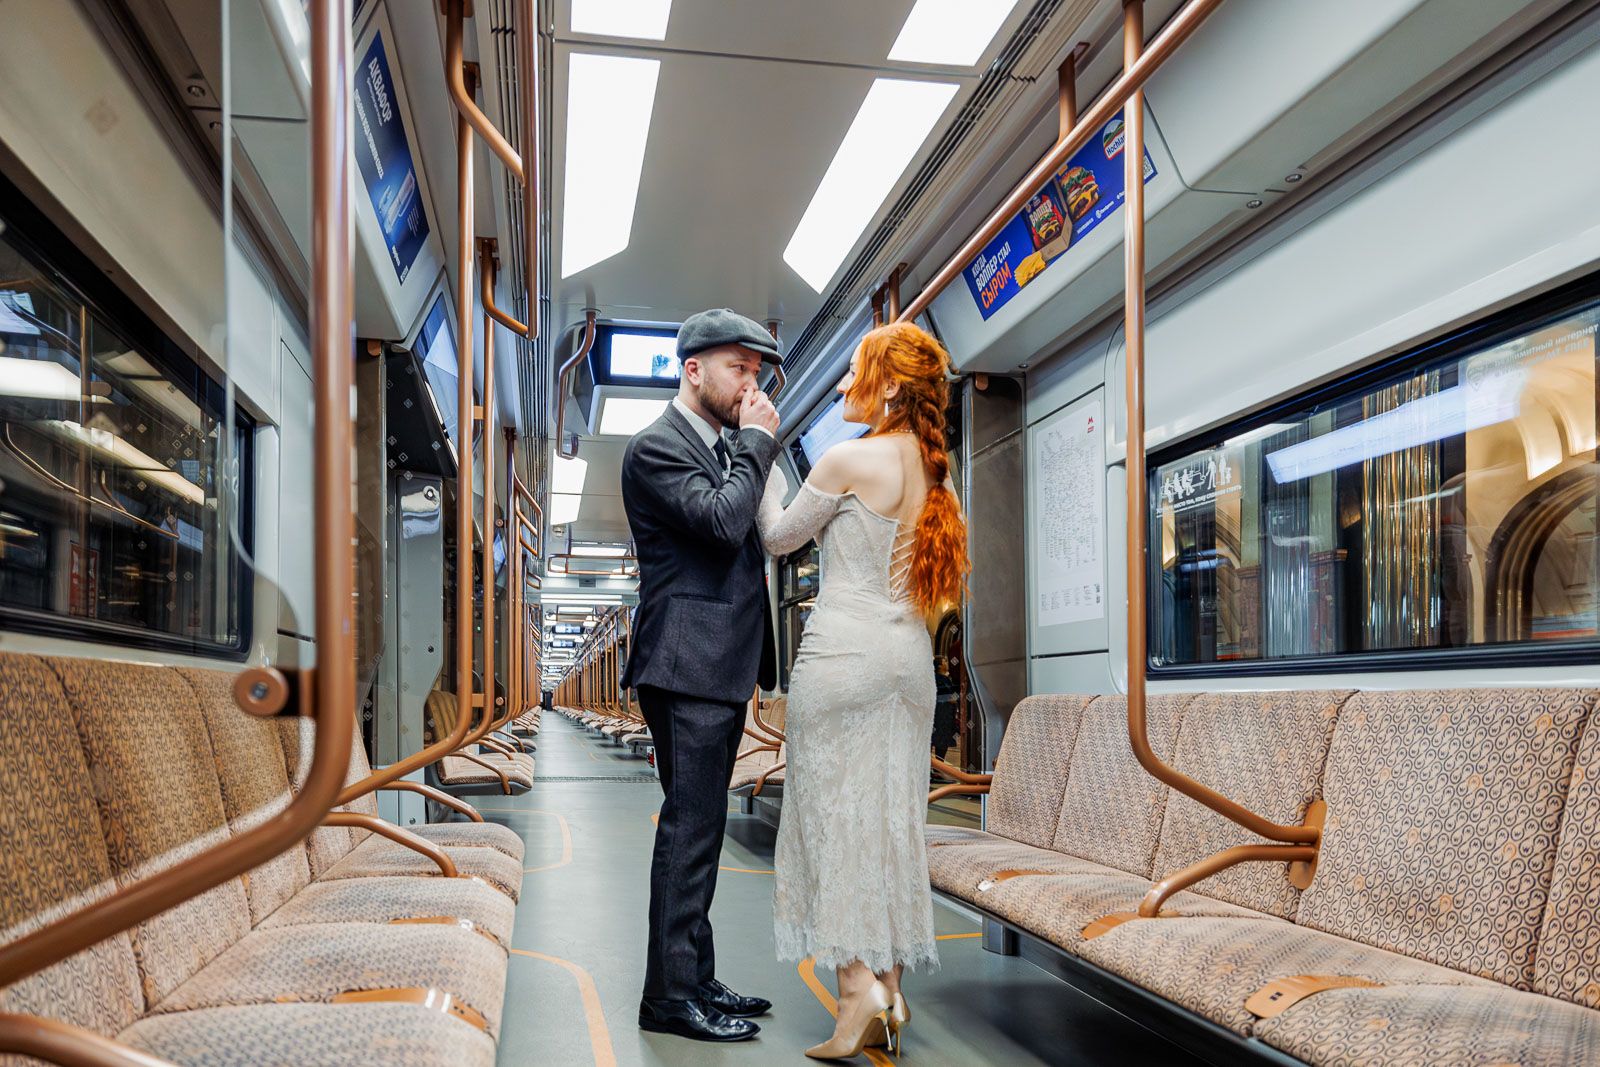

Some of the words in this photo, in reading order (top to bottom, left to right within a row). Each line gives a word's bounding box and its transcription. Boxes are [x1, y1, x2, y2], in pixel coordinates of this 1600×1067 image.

[368, 57, 392, 124] АКВАФОР
[1106, 135, 1125, 157] Hochla
[971, 254, 988, 277] КОГДА
[975, 258, 998, 291] ВОППЕР
[997, 241, 1012, 266] СТАЛ
[981, 261, 1013, 310] СЫРОМ
